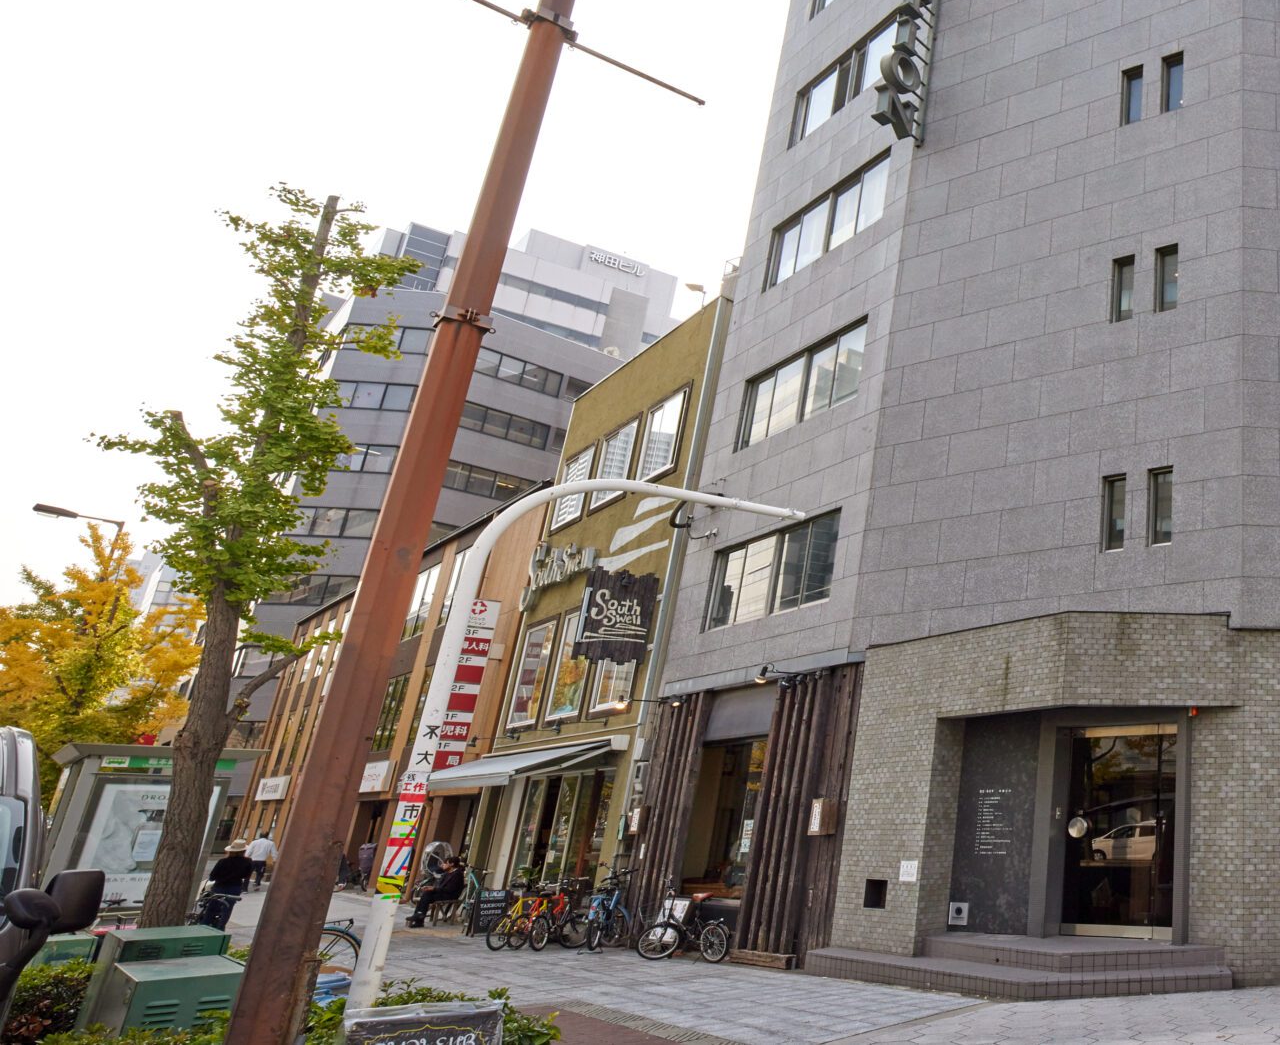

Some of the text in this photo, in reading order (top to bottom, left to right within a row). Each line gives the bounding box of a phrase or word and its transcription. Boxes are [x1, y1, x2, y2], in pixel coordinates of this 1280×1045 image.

[590, 250, 645, 276] 神田ビル
[591, 589, 641, 619] South
[603, 610, 641, 626] Swell
[458, 656, 472, 664] 2F
[451, 684, 466, 692] 2F
[141, 793, 169, 802] DRO
